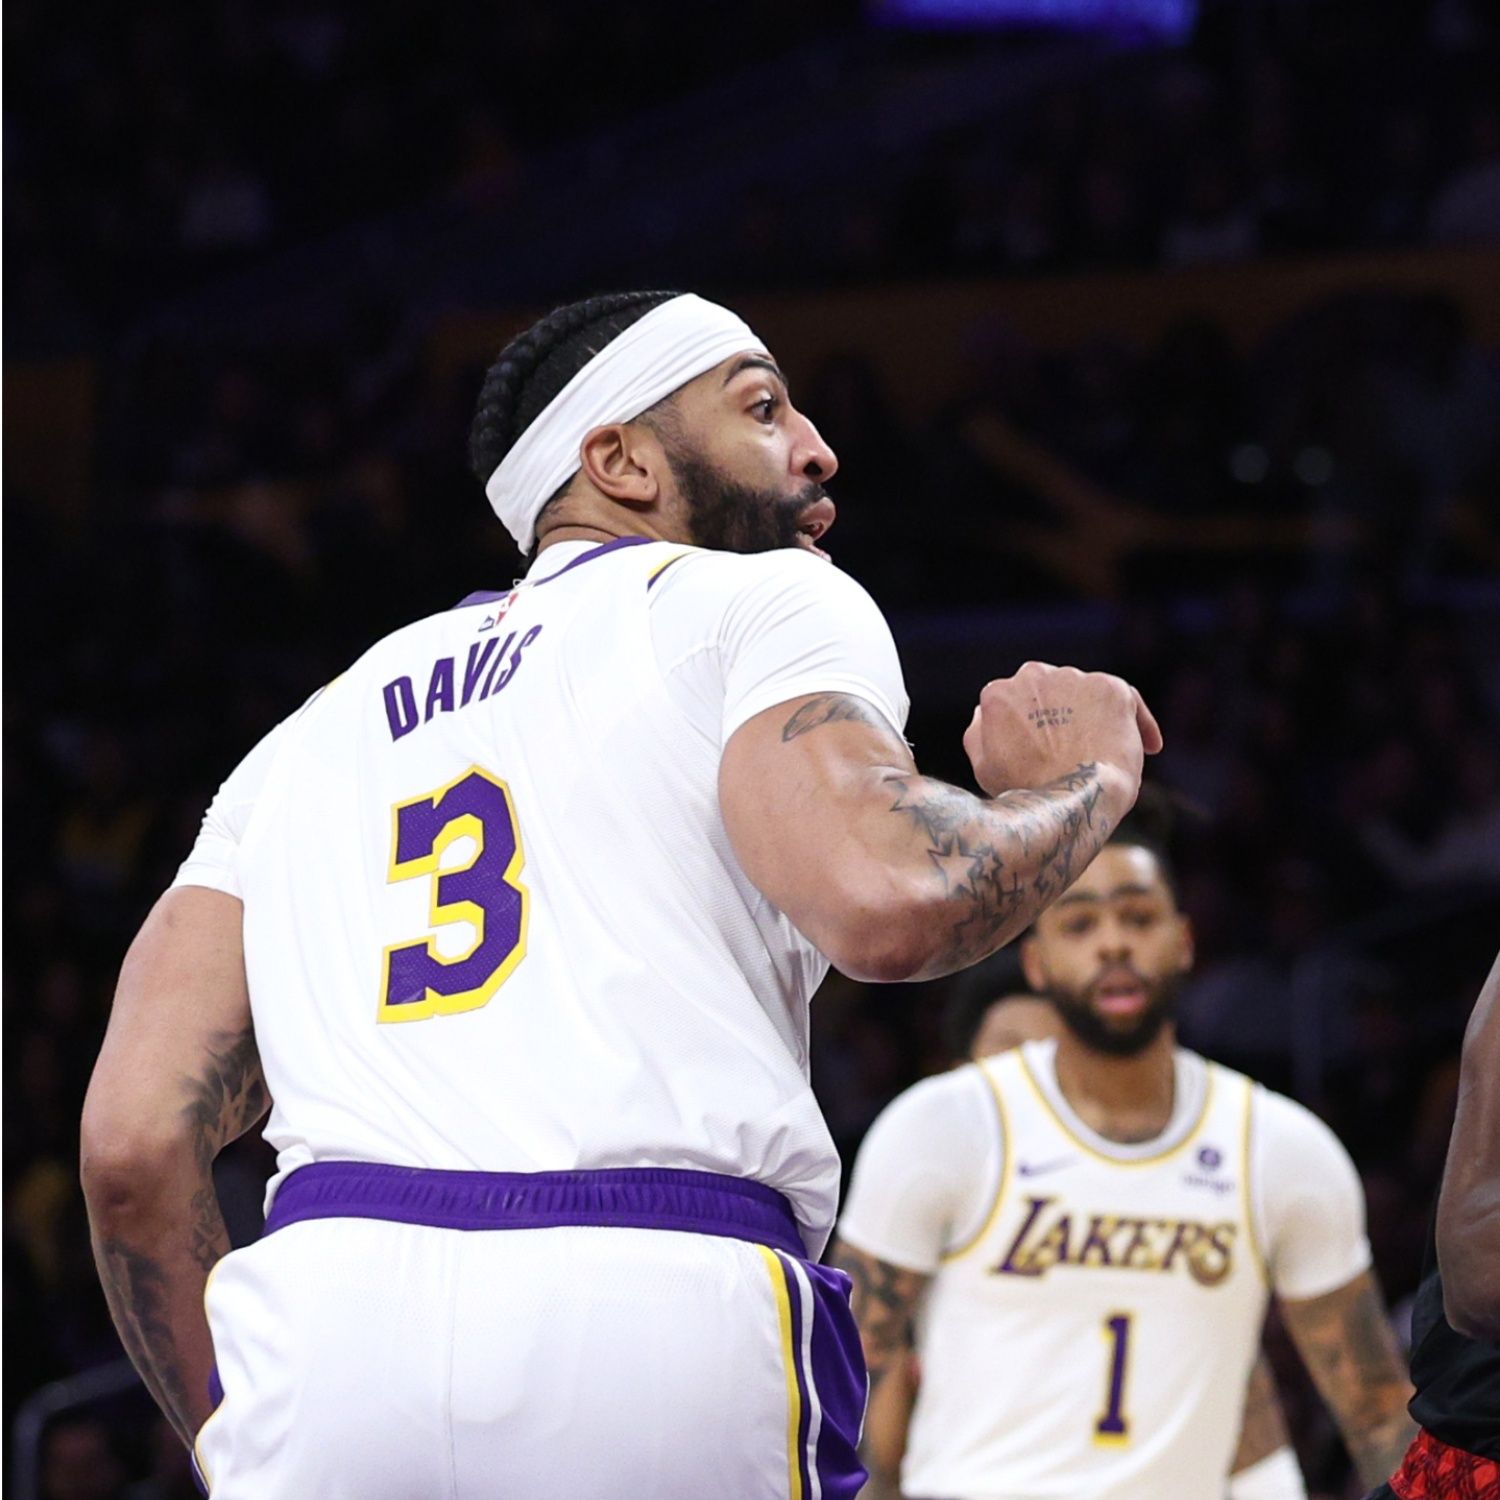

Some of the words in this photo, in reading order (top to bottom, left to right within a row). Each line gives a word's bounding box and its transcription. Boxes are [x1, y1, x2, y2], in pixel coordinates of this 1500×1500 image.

[382, 624, 543, 742] DAVIS
[376, 763, 530, 1024] 3
[989, 1196, 1237, 1288] LAKERS
[1093, 1311, 1135, 1448] 1
